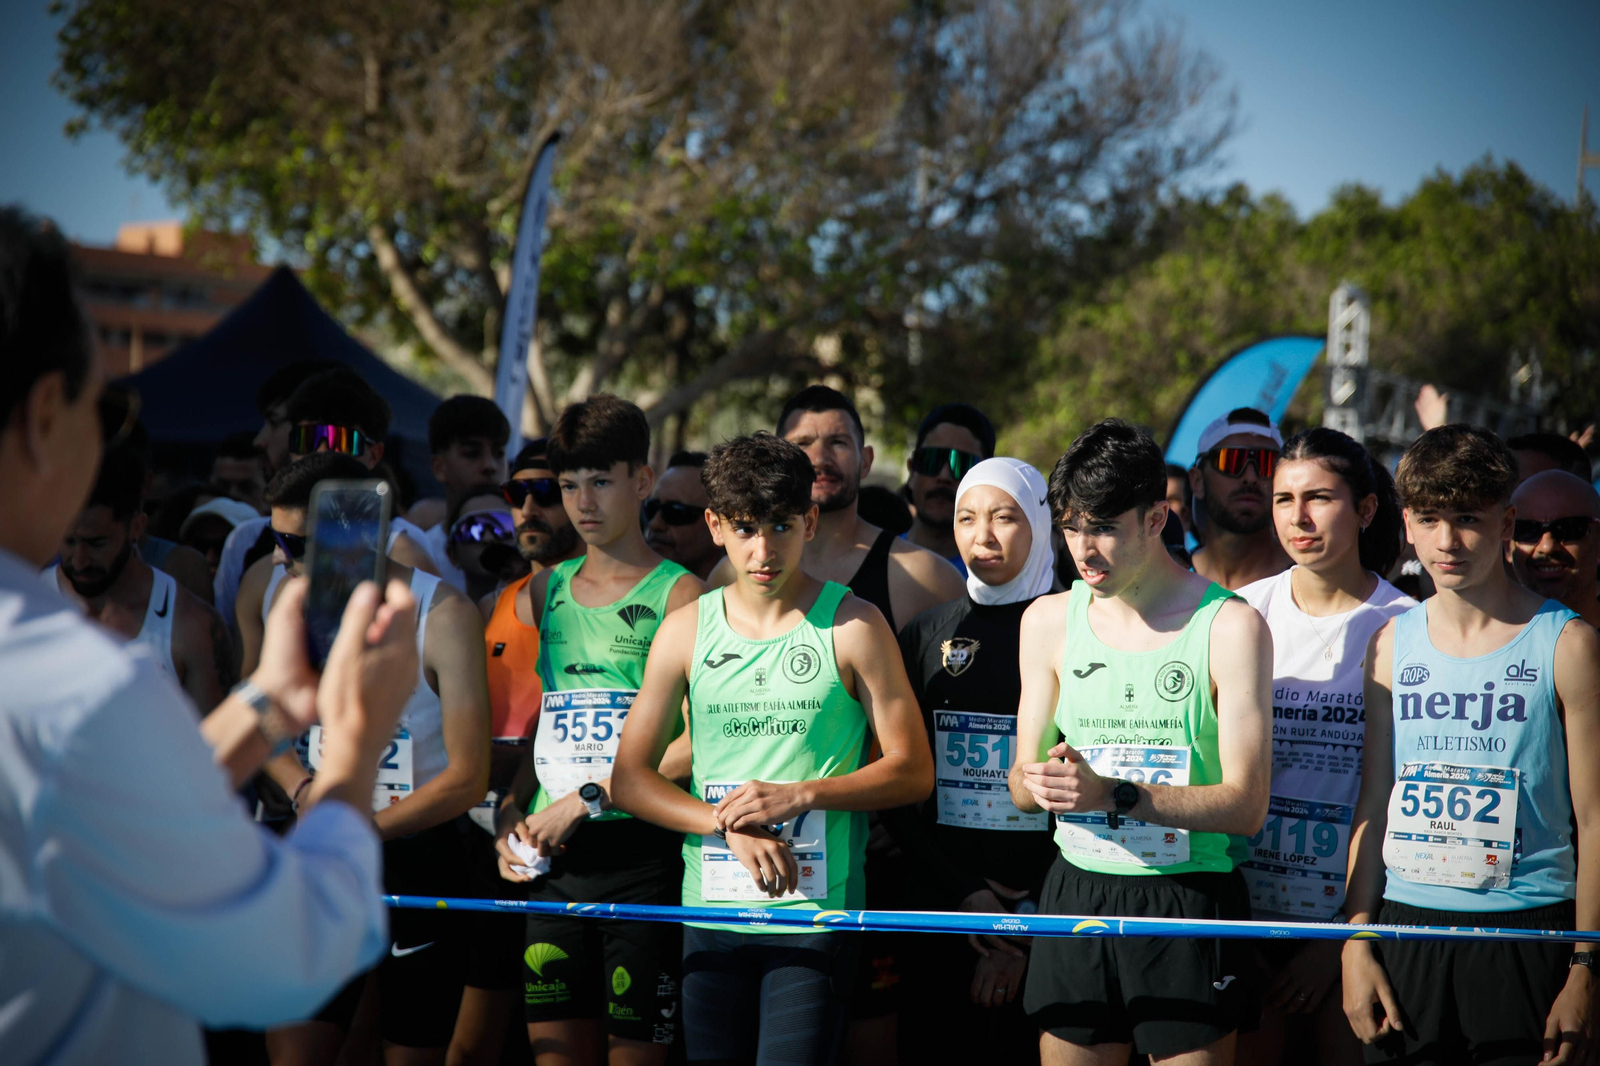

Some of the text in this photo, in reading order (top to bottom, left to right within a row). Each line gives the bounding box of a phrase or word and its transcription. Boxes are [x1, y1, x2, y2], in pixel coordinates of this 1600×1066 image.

[614, 634, 652, 647] Unicaja
[609, 648, 640, 656] Fundación
[592, 697, 611, 705] 2024
[1275, 687, 1363, 706] dio Marató
[723, 702, 760, 713] ATLETISMO
[764, 698, 786, 711] BAHÍA
[787, 697, 821, 711] ALMERÍA
[1399, 681, 1528, 731] nerja
[987, 717, 1012, 725] Maratón
[1322, 705, 1366, 725] 2024
[723, 715, 806, 738] eCoCulture
[968, 721, 1011, 731] Almería 2024
[1092, 718, 1127, 729] ATLETISMO
[1129, 717, 1149, 729] BAHÍA
[1150, 716, 1183, 729] ALMERÍA
[1273, 725, 1363, 742] ÓN RUIZ ANDÚJA
[574, 743, 604, 751] MARIO
[1416, 735, 1507, 753] ATLETISMO
[946, 733, 1010, 769] 551
[963, 768, 1008, 779] NOUHAYL
[1424, 770, 1449, 779] Almería
[1450, 772, 1470, 780] 2024
[1444, 766, 1471, 774] Maratón
[1270, 803, 1290, 811] Almería
[1291, 807, 1309, 815] 2024
[1401, 783, 1501, 825] 5562
[1430, 820, 1456, 831] RAUL
[1254, 848, 1317, 865] IRENE LÓPEZ
[1414, 852, 1434, 860] NEXAL
[525, 979, 567, 992] Unicaja
[613, 1003, 633, 1016] Jaén
